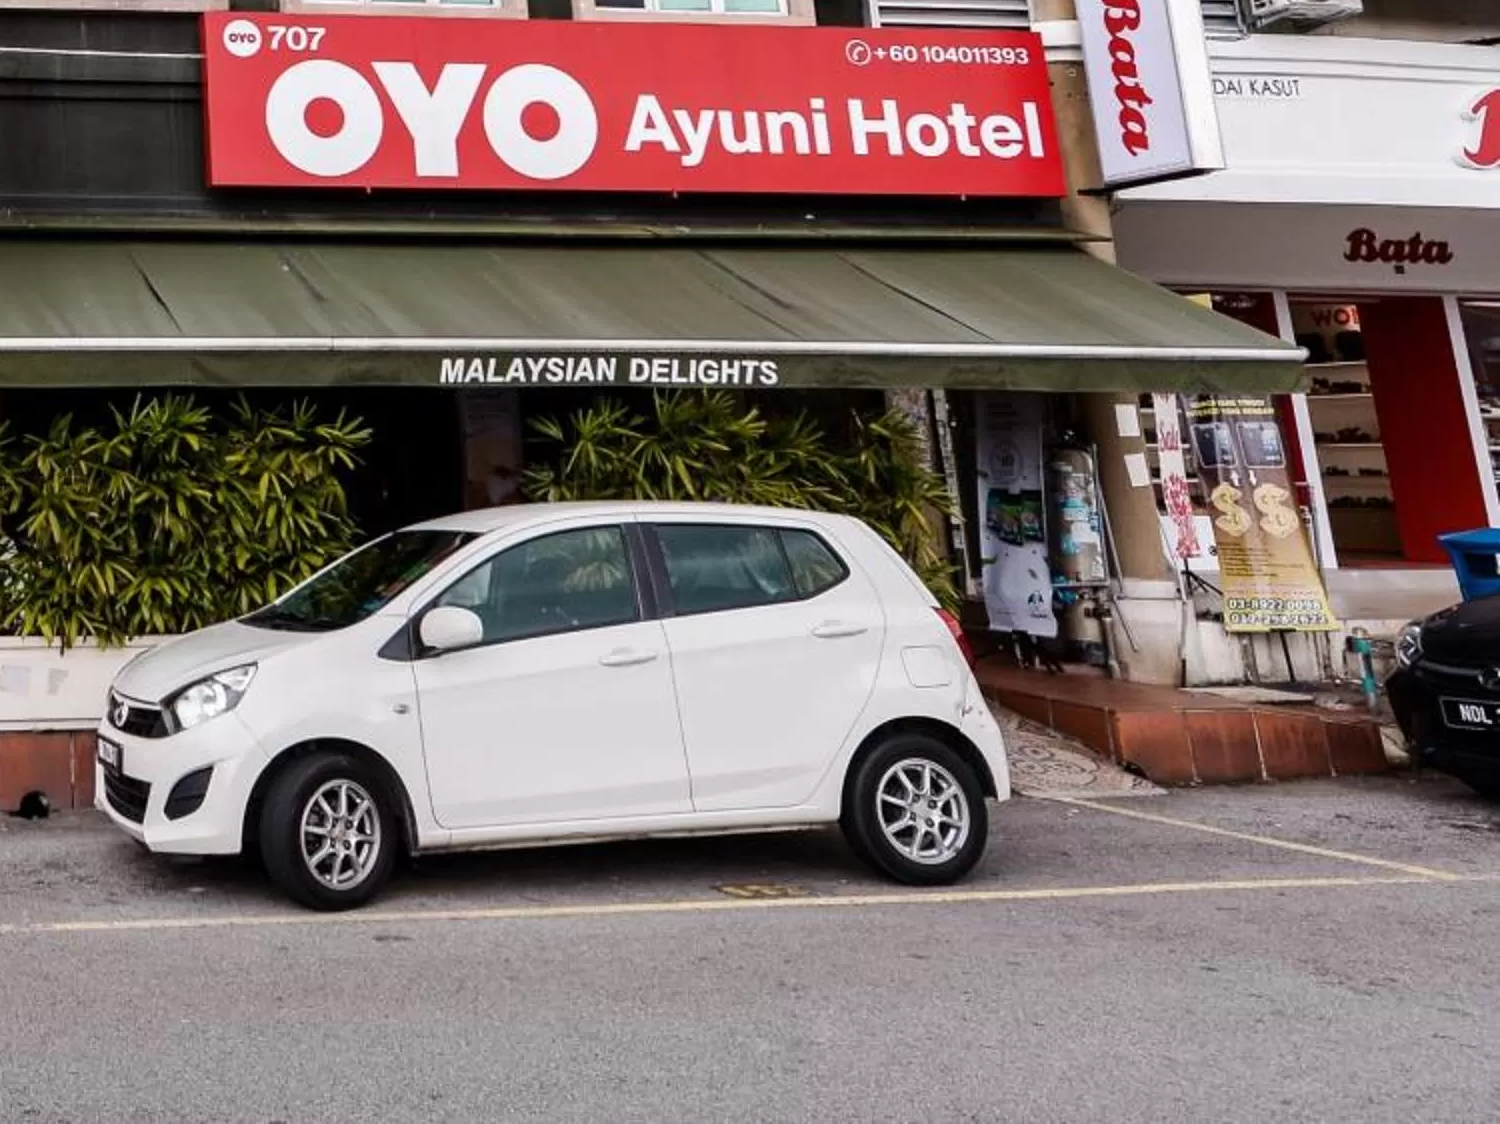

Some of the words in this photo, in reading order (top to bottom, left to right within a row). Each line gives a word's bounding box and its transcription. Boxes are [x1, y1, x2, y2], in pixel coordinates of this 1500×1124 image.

[267, 26, 327, 51] 707
[873, 45, 918, 63] +60
[922, 46, 1030, 65] 104011393
[1251, 79, 1301, 97] KASUT
[265, 59, 599, 180] OYO
[624, 93, 831, 168] Ayuni
[850, 98, 1045, 160] Hotel
[1343, 228, 1454, 265] Bata
[439, 357, 618, 385] MALAYSIAN
[628, 359, 780, 386] DELIGHTS
[1459, 703, 1493, 725] NDL
